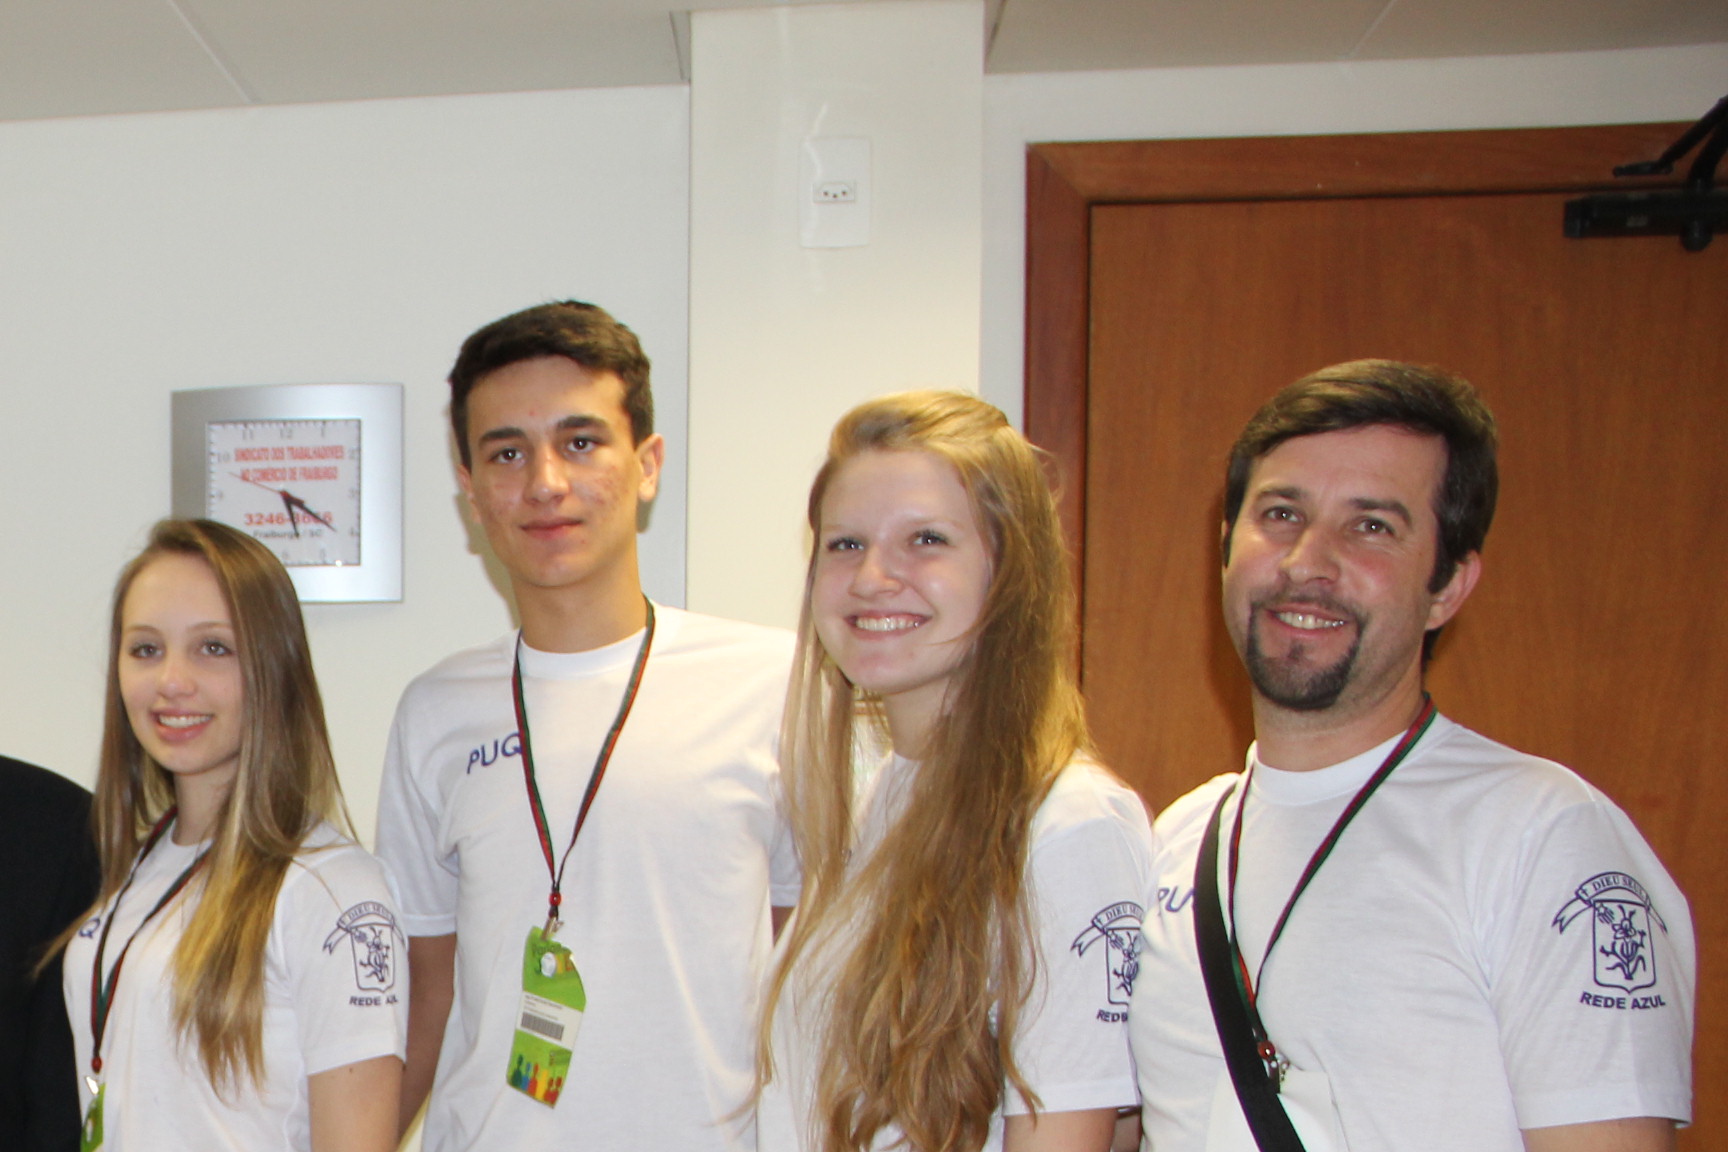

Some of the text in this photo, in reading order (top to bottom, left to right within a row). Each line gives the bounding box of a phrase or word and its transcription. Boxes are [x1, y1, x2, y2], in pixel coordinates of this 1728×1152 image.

[1591, 875, 1621, 892] DIEU
[348, 994, 382, 1007] REDE
[1579, 991, 1667, 1010] REDE AZUL
